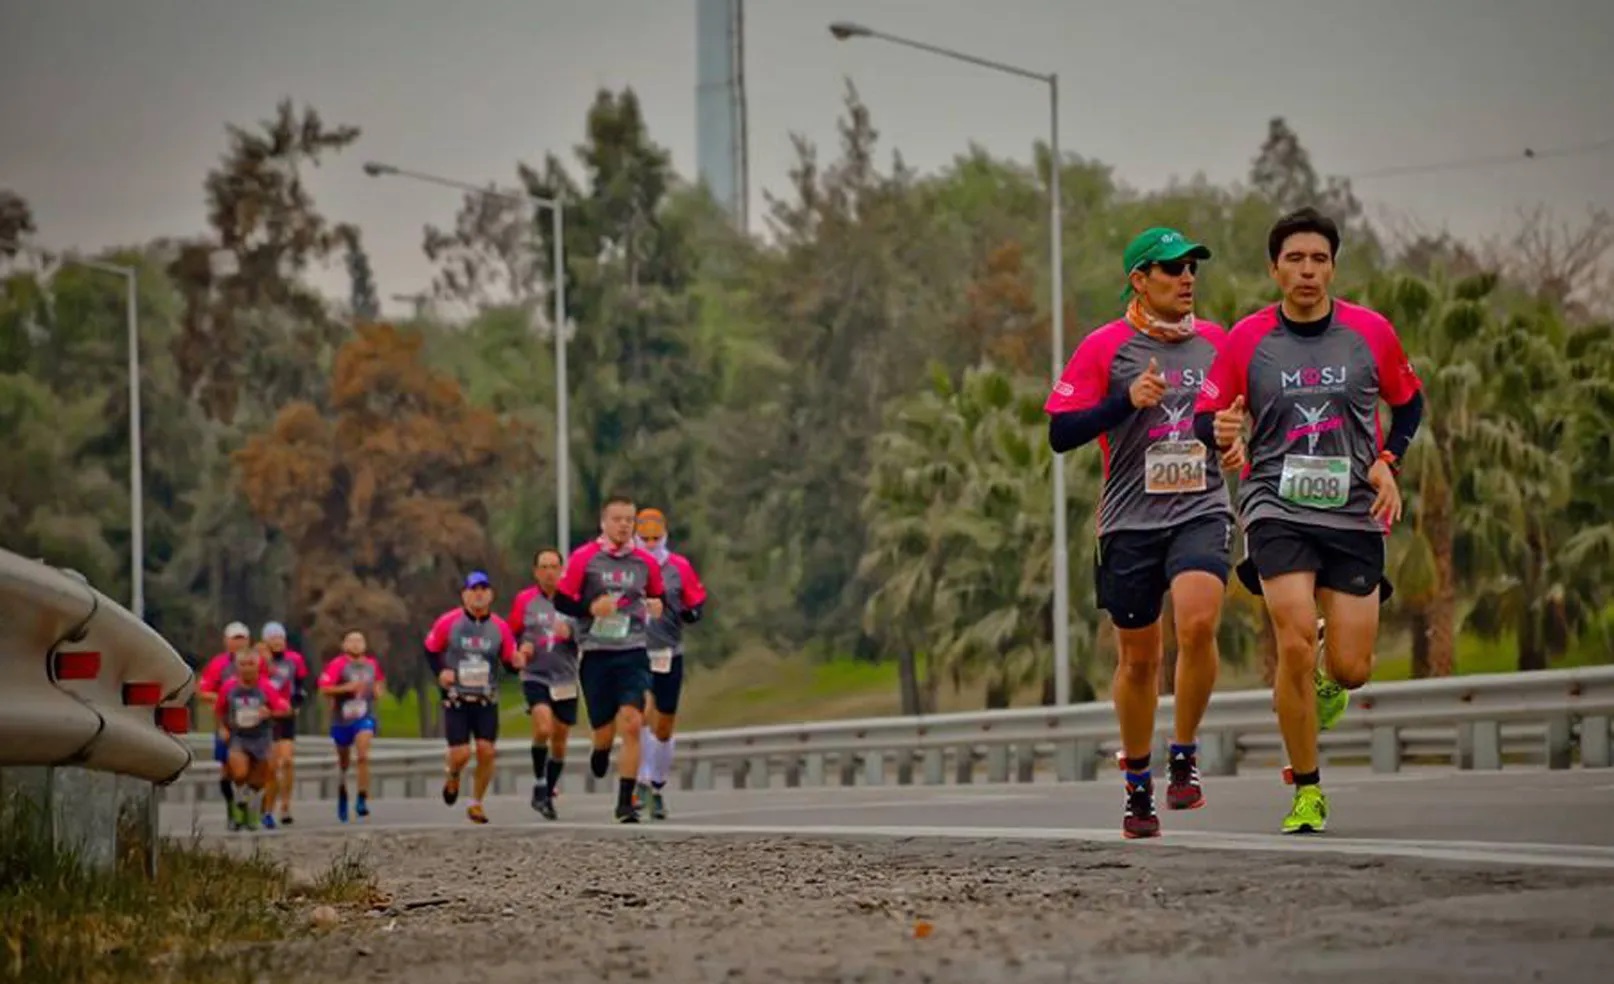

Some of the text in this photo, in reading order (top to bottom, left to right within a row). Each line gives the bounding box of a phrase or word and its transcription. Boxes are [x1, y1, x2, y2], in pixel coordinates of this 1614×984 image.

[1160, 368, 1204, 388] OSJ
[1281, 366, 1346, 388] MOSJ
[1286, 475, 1340, 500] 1098
